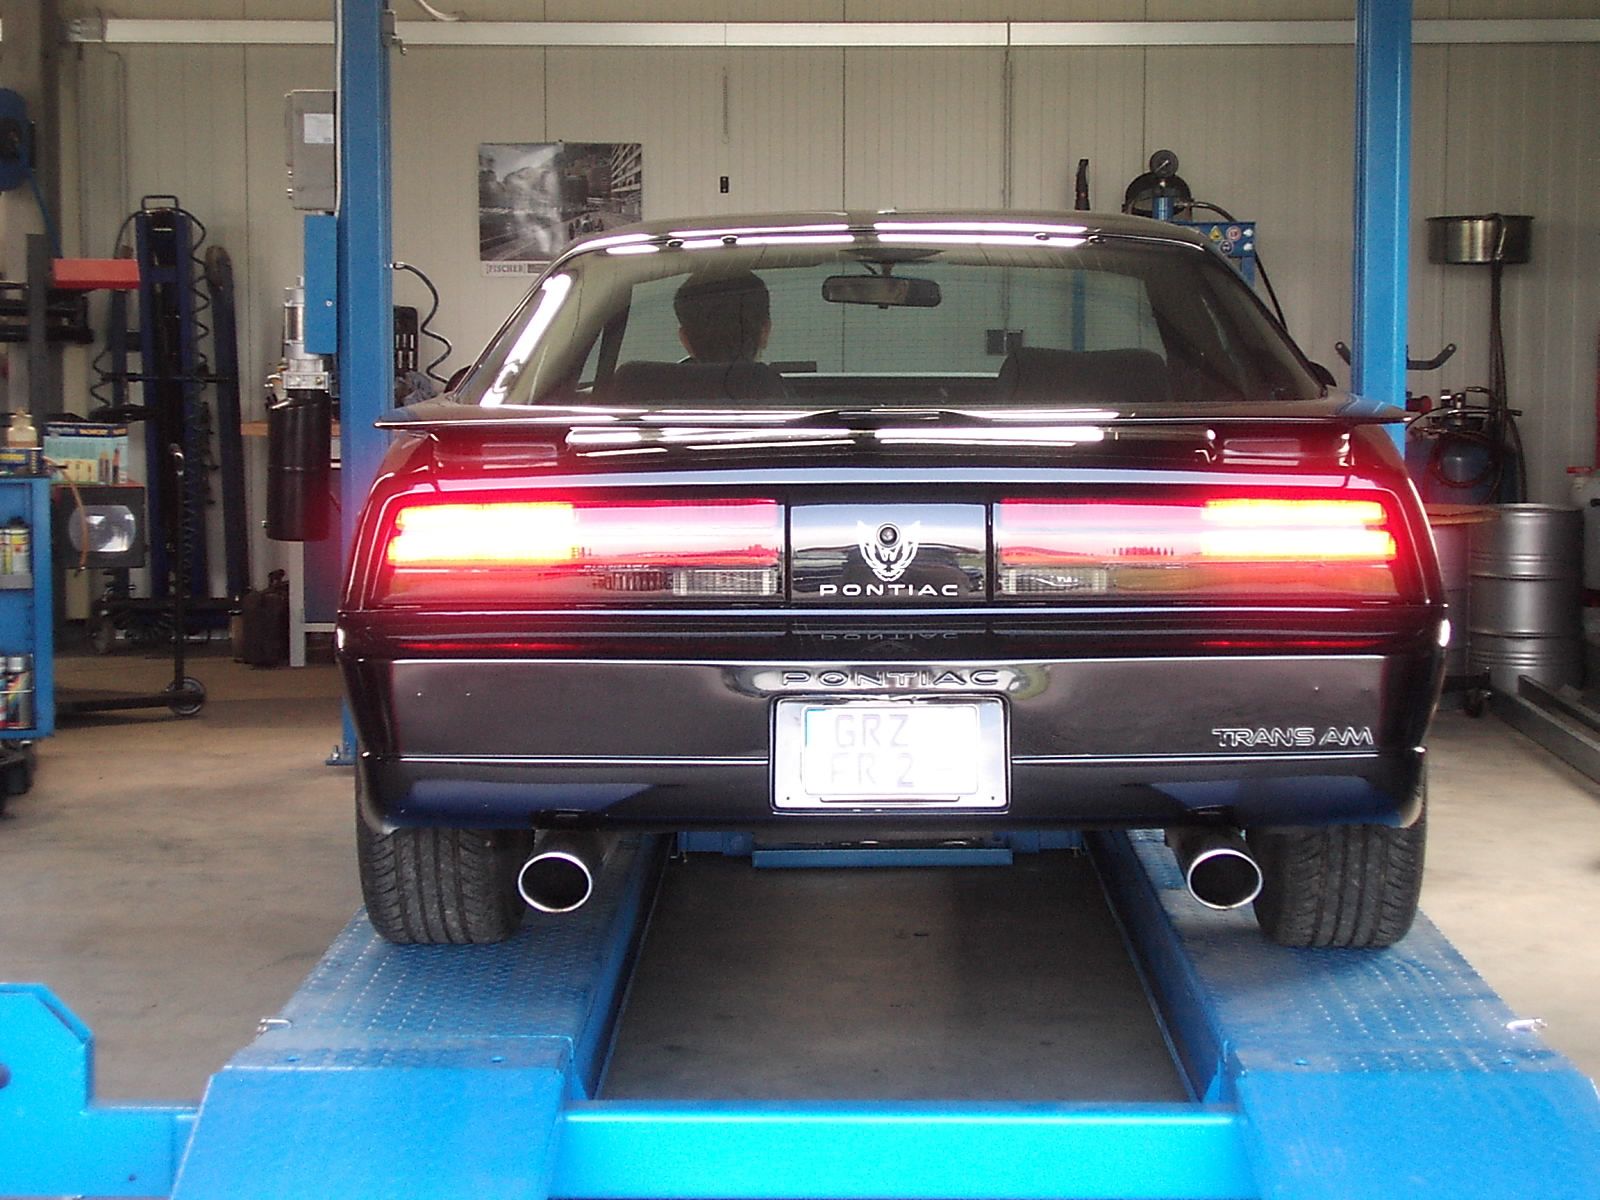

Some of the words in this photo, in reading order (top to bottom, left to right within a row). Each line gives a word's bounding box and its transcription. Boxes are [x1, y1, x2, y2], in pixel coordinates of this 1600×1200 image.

[819, 584, 959, 596] PONTIAC
[782, 669, 1000, 687] PONTIAC
[834, 713, 909, 748] GRZ
[1212, 727, 1316, 747] TRANS
[1318, 727, 1374, 746] AM
